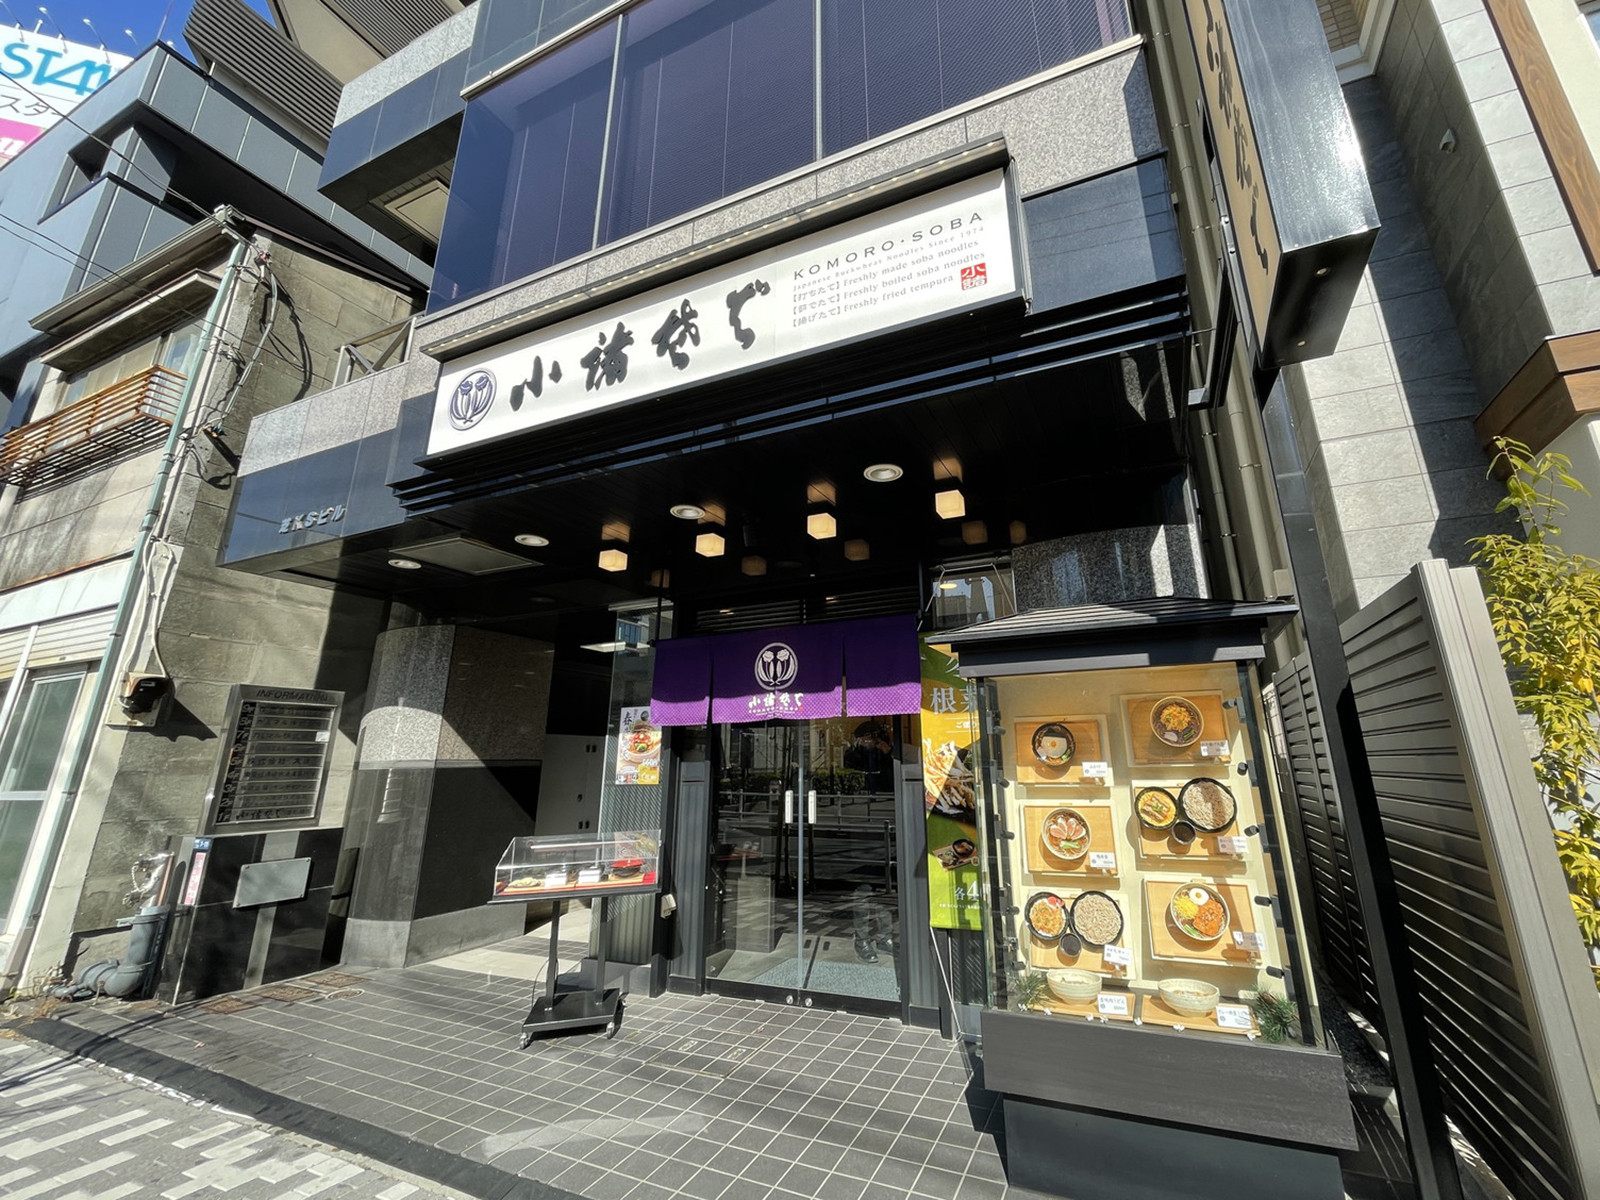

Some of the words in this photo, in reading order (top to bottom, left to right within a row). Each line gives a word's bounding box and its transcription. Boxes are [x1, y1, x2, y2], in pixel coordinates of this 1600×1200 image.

[886, 246, 924, 261] Noodles
[960, 226, 984, 238] 1974
[843, 271, 879, 287] Freshly
[881, 262, 908, 275] made
[911, 254, 934, 266] soba
[937, 240, 979, 258] noodles
[843, 284, 879, 299] Freshly
[881, 273, 913, 288] boiled
[916, 265, 940, 277] soba
[943, 252, 985, 269] noodles
[843, 297, 879, 312] Freshly
[881, 287, 907, 301] fried
[910, 275, 953, 293] tempura
[256, 689, 329, 702] INFORMATION
